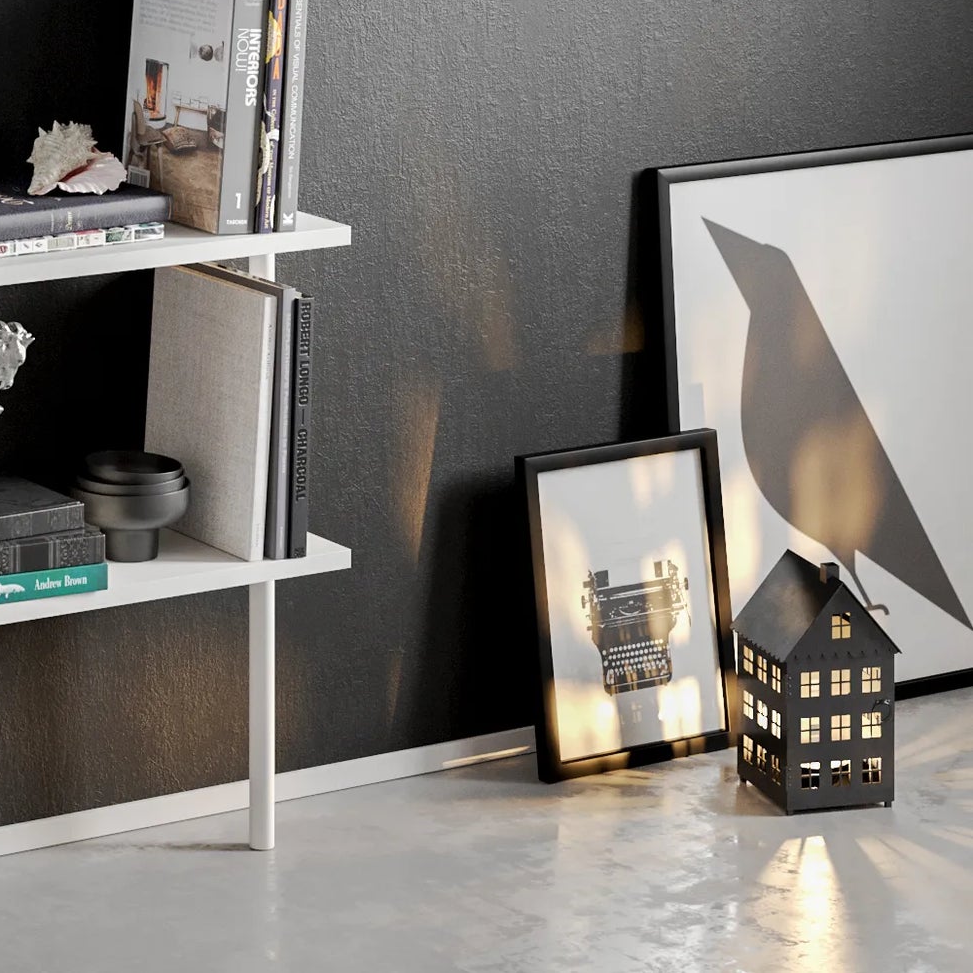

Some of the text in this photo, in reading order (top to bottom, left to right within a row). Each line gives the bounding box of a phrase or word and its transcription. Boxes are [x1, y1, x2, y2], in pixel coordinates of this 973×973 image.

[235, 28, 249, 72] NOW!
[245, 28, 262, 107] INTERIORS
[294, 40, 300, 52] OF
[288, 85, 298, 160] COMMUNICATION
[235, 193, 241, 209] 1
[296, 302, 311, 502] ROBERT LONGO CHARCOAL
[34, 574, 88, 591] Andrew Brown
